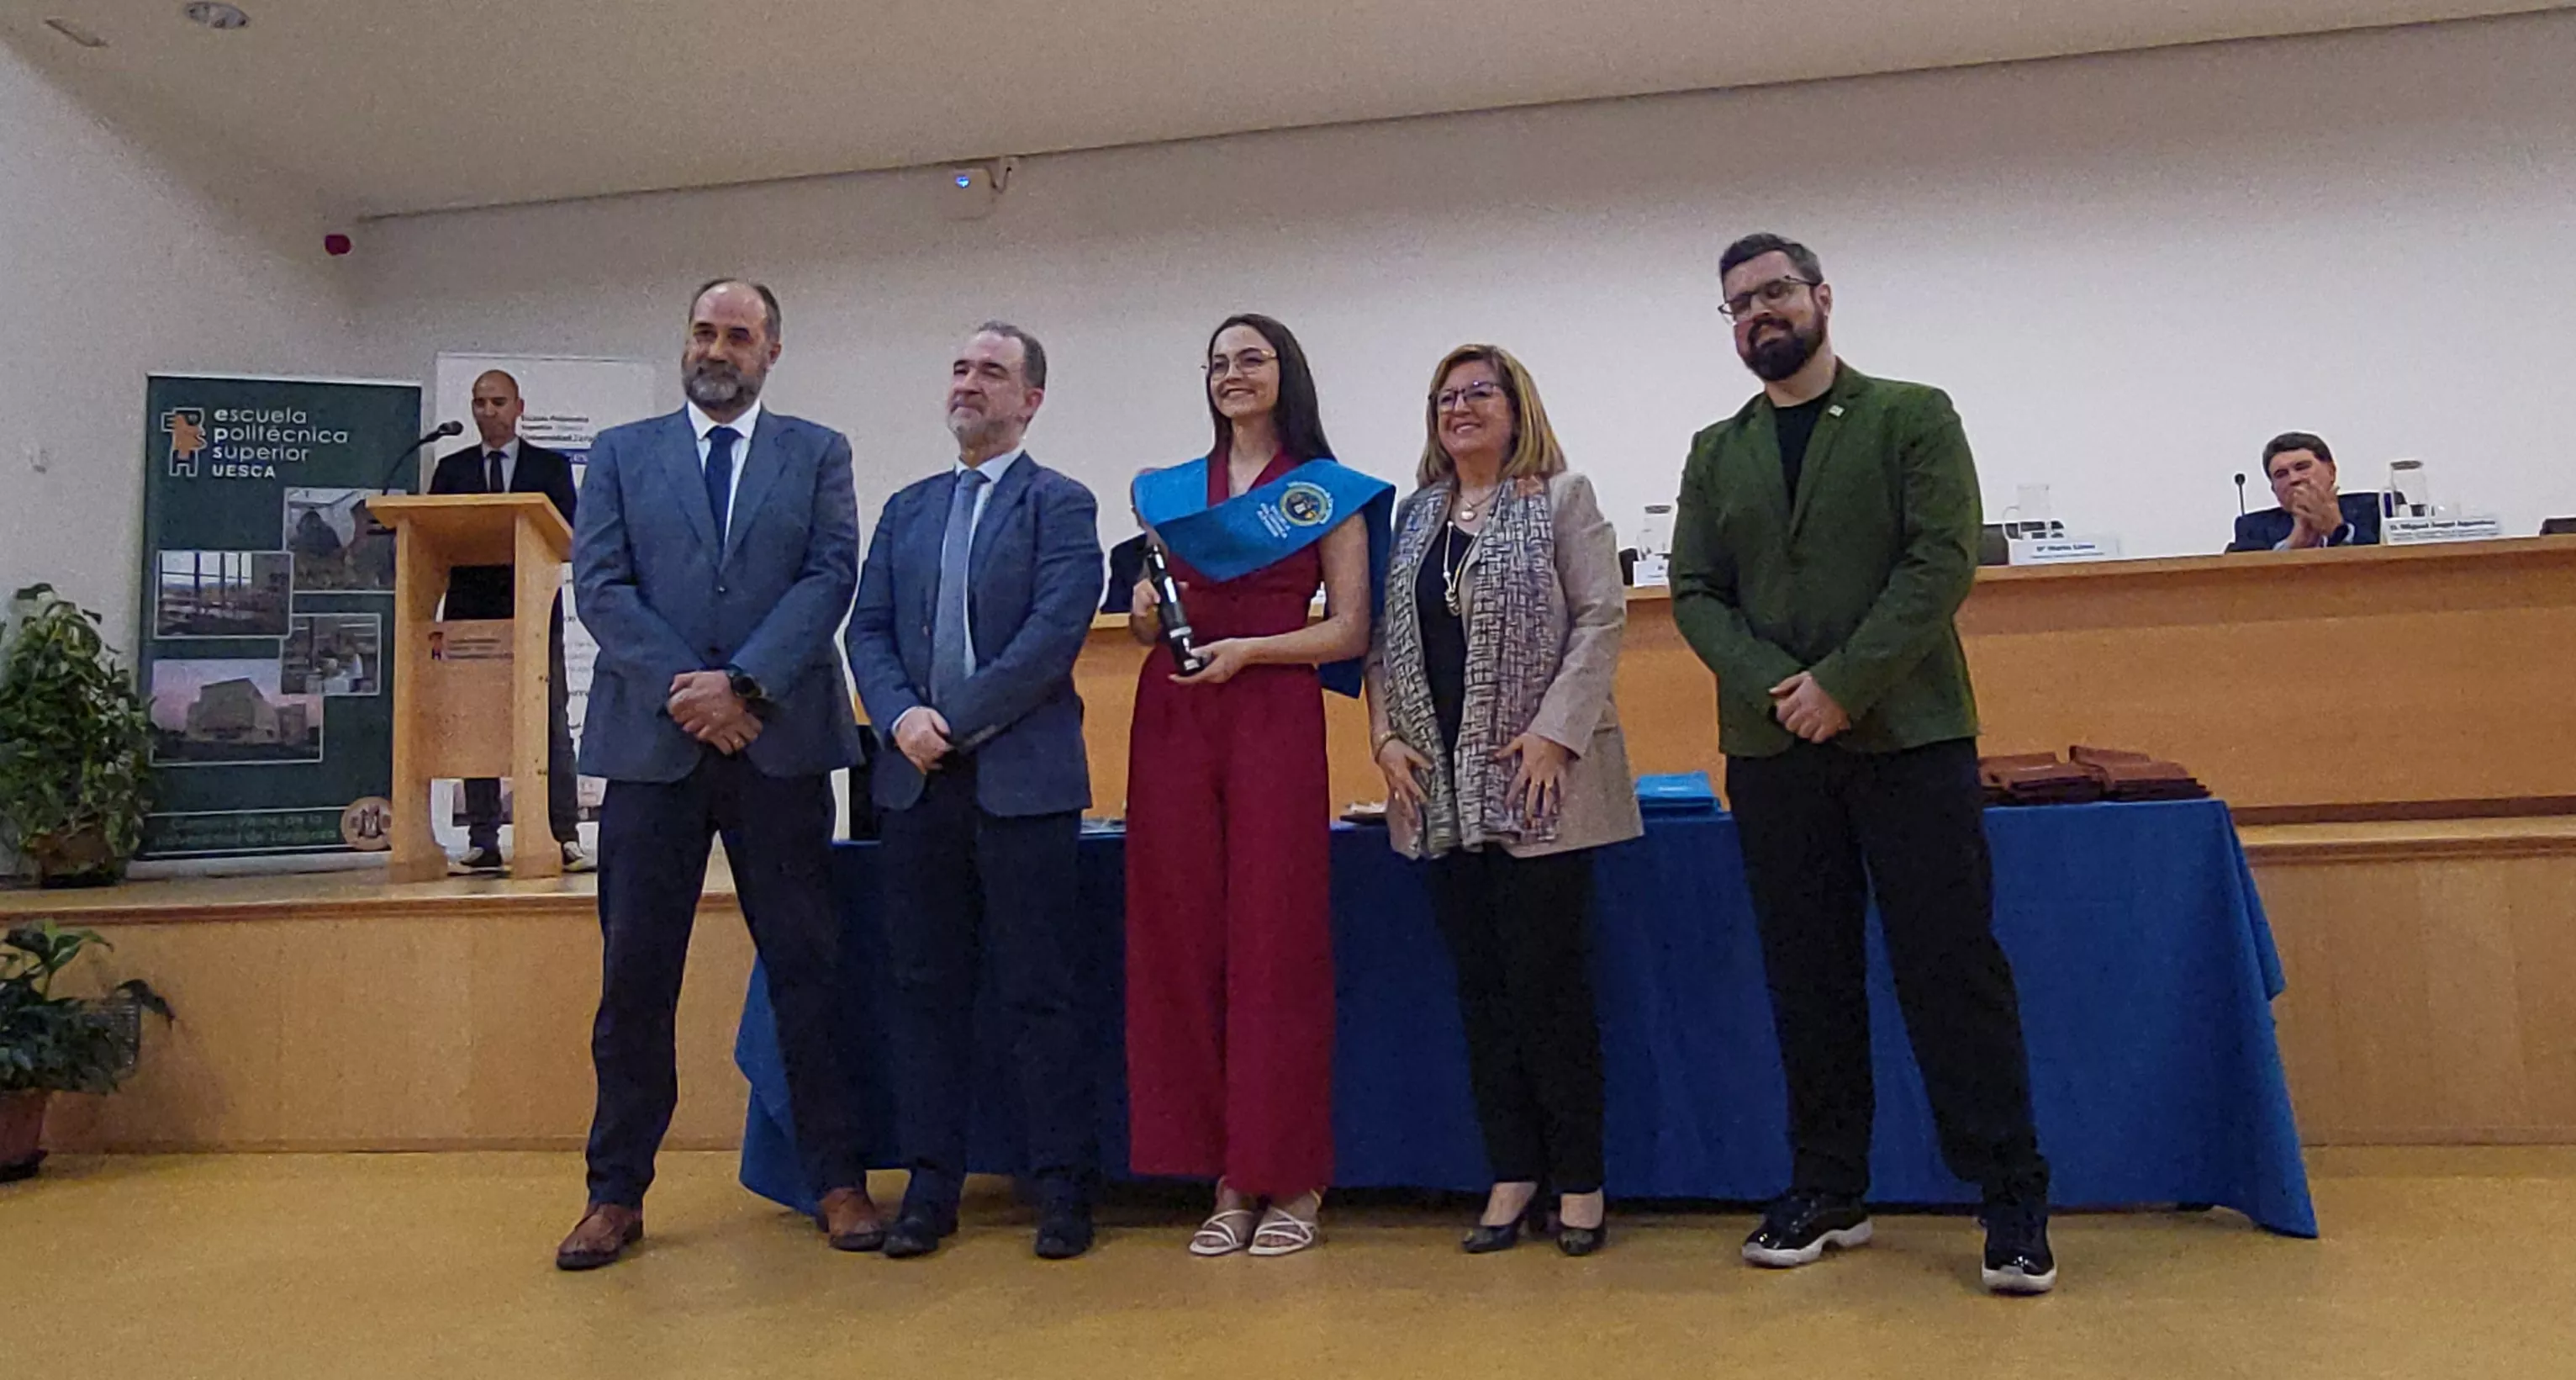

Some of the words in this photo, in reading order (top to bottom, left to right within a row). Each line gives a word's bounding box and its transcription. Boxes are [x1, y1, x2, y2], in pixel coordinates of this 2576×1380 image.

[214, 406, 308, 425] escuela
[213, 424, 349, 444] politécnica
[212, 444, 310, 463] superior
[212, 463, 276, 479] UESCA
